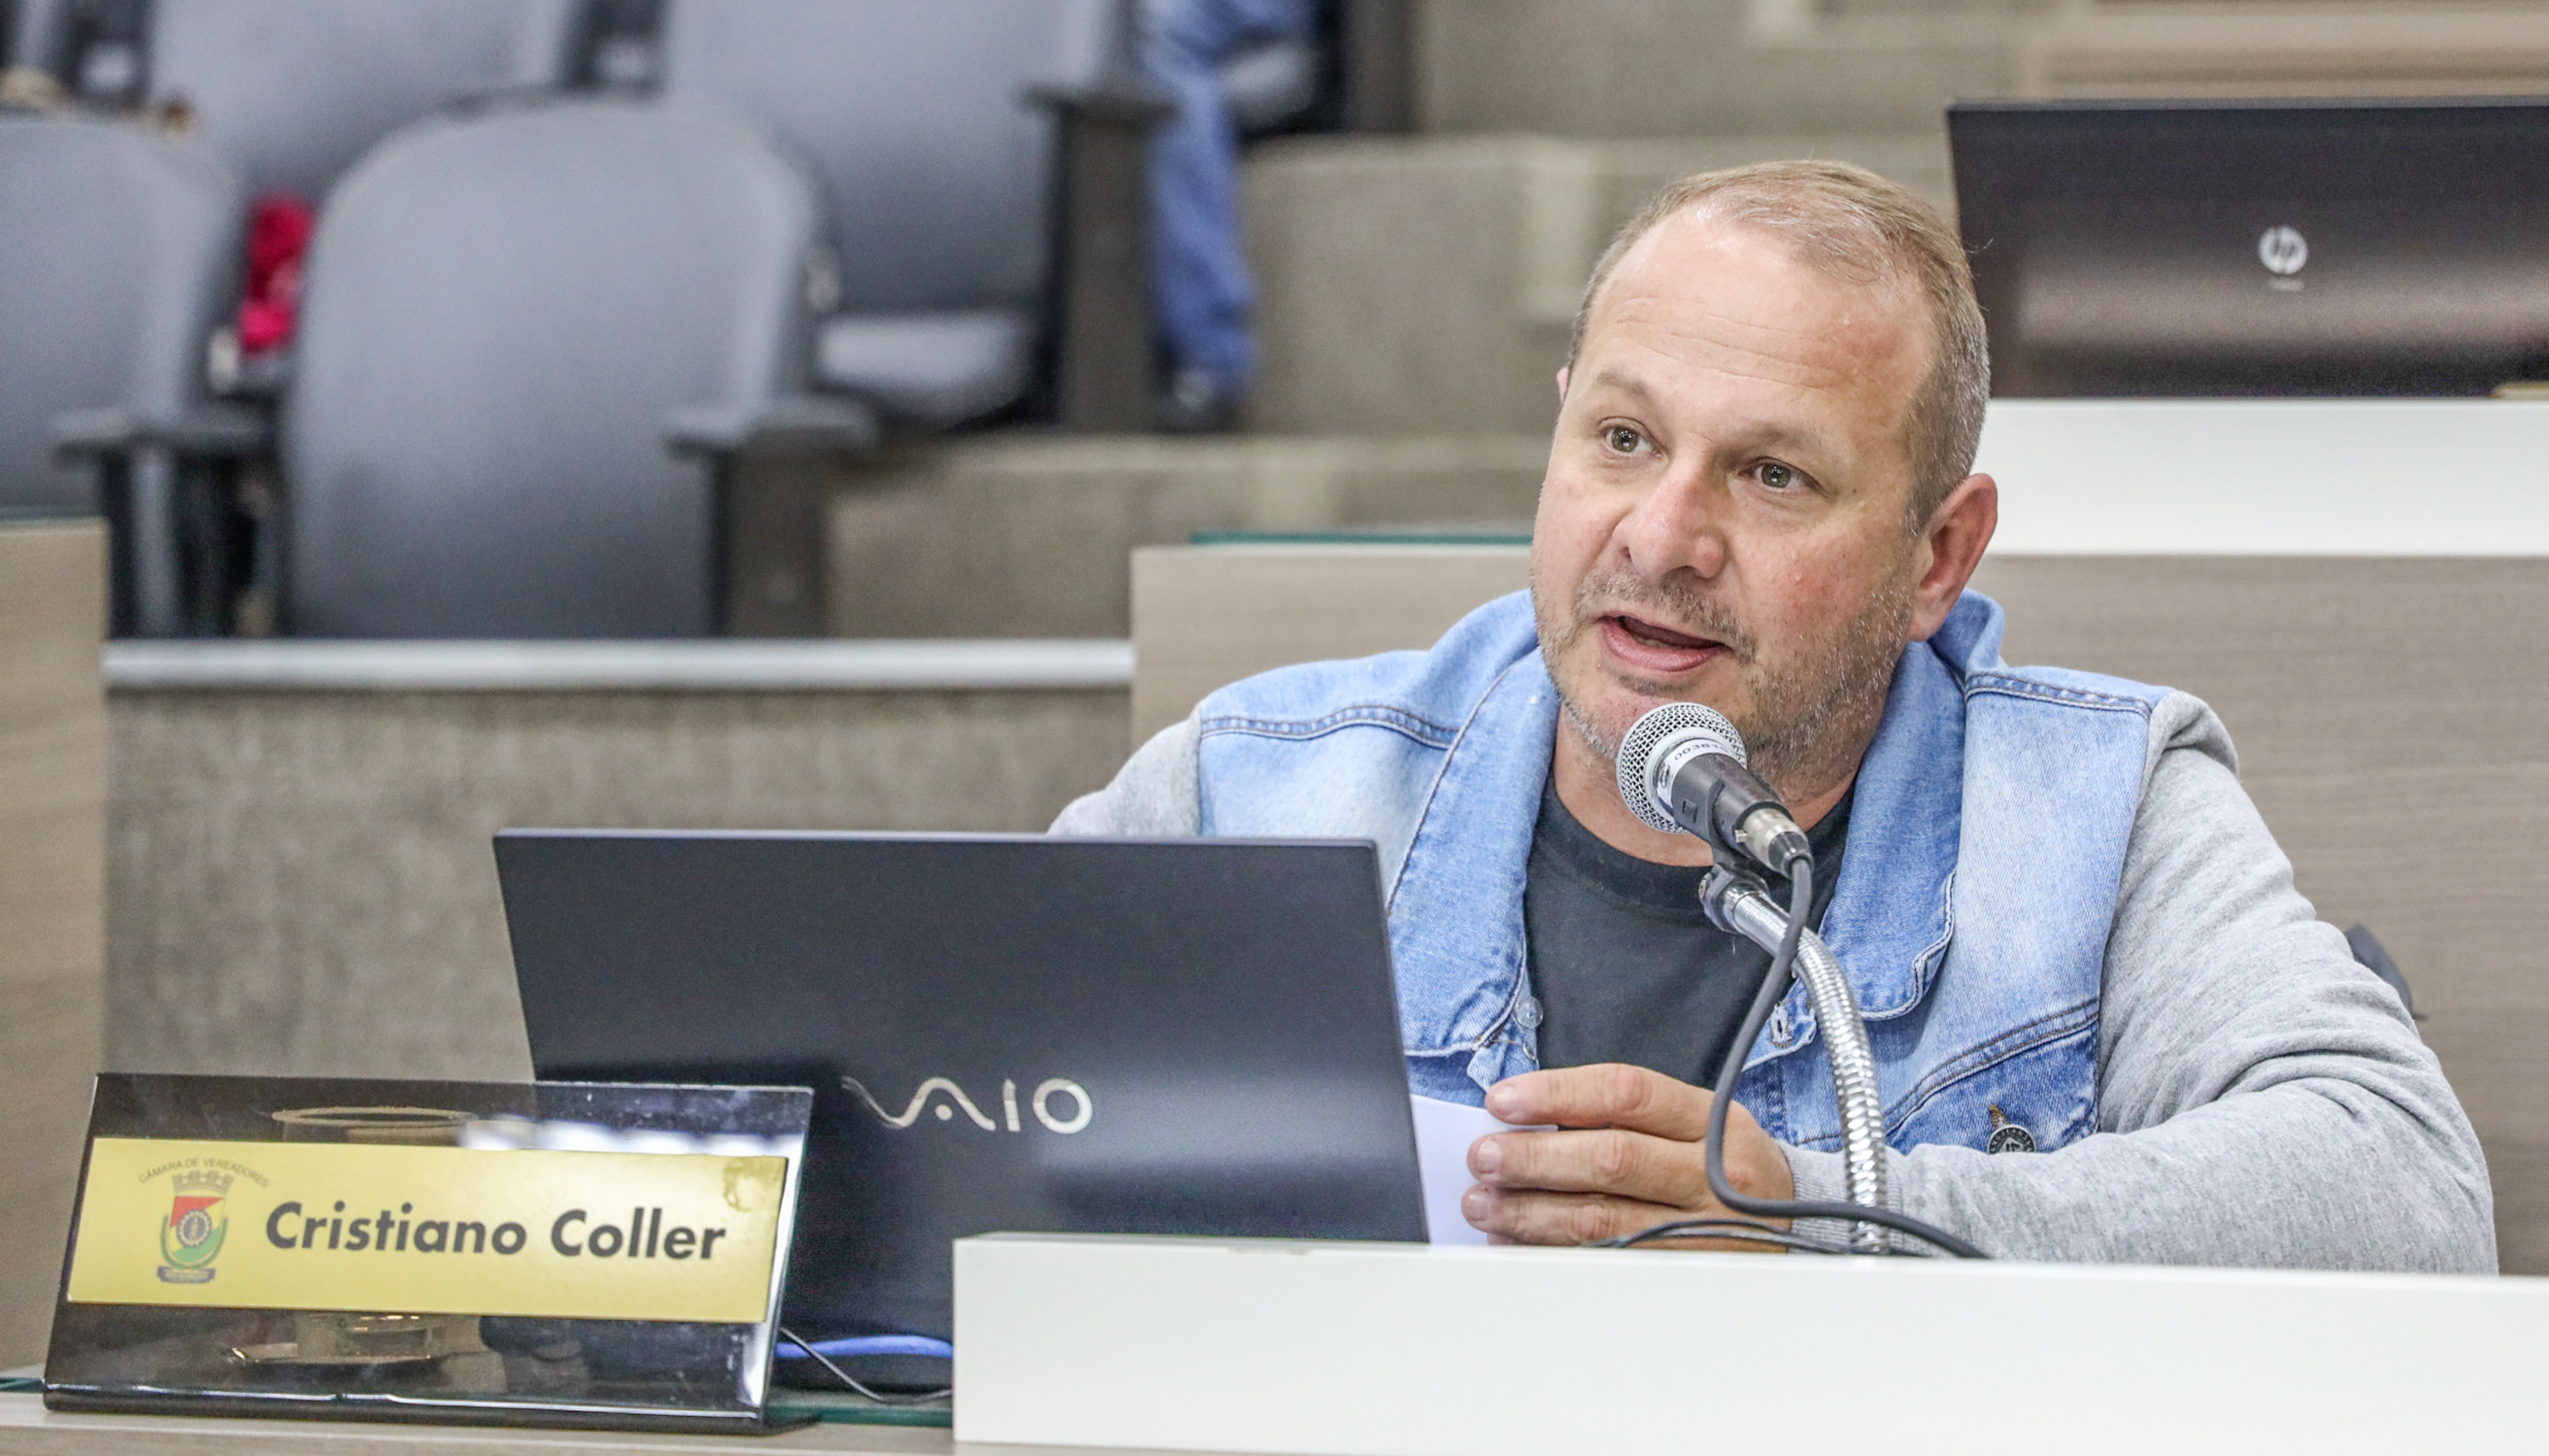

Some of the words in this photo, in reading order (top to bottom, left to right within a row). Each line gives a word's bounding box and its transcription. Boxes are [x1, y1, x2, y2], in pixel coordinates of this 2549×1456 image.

[841, 1076, 1094, 1135] VAIO
[184, 1158, 199, 1168] DE
[202, 1157, 270, 1188] VEREADORES
[266, 1200, 527, 1256] Cristiano
[551, 1207, 726, 1260] Coller
